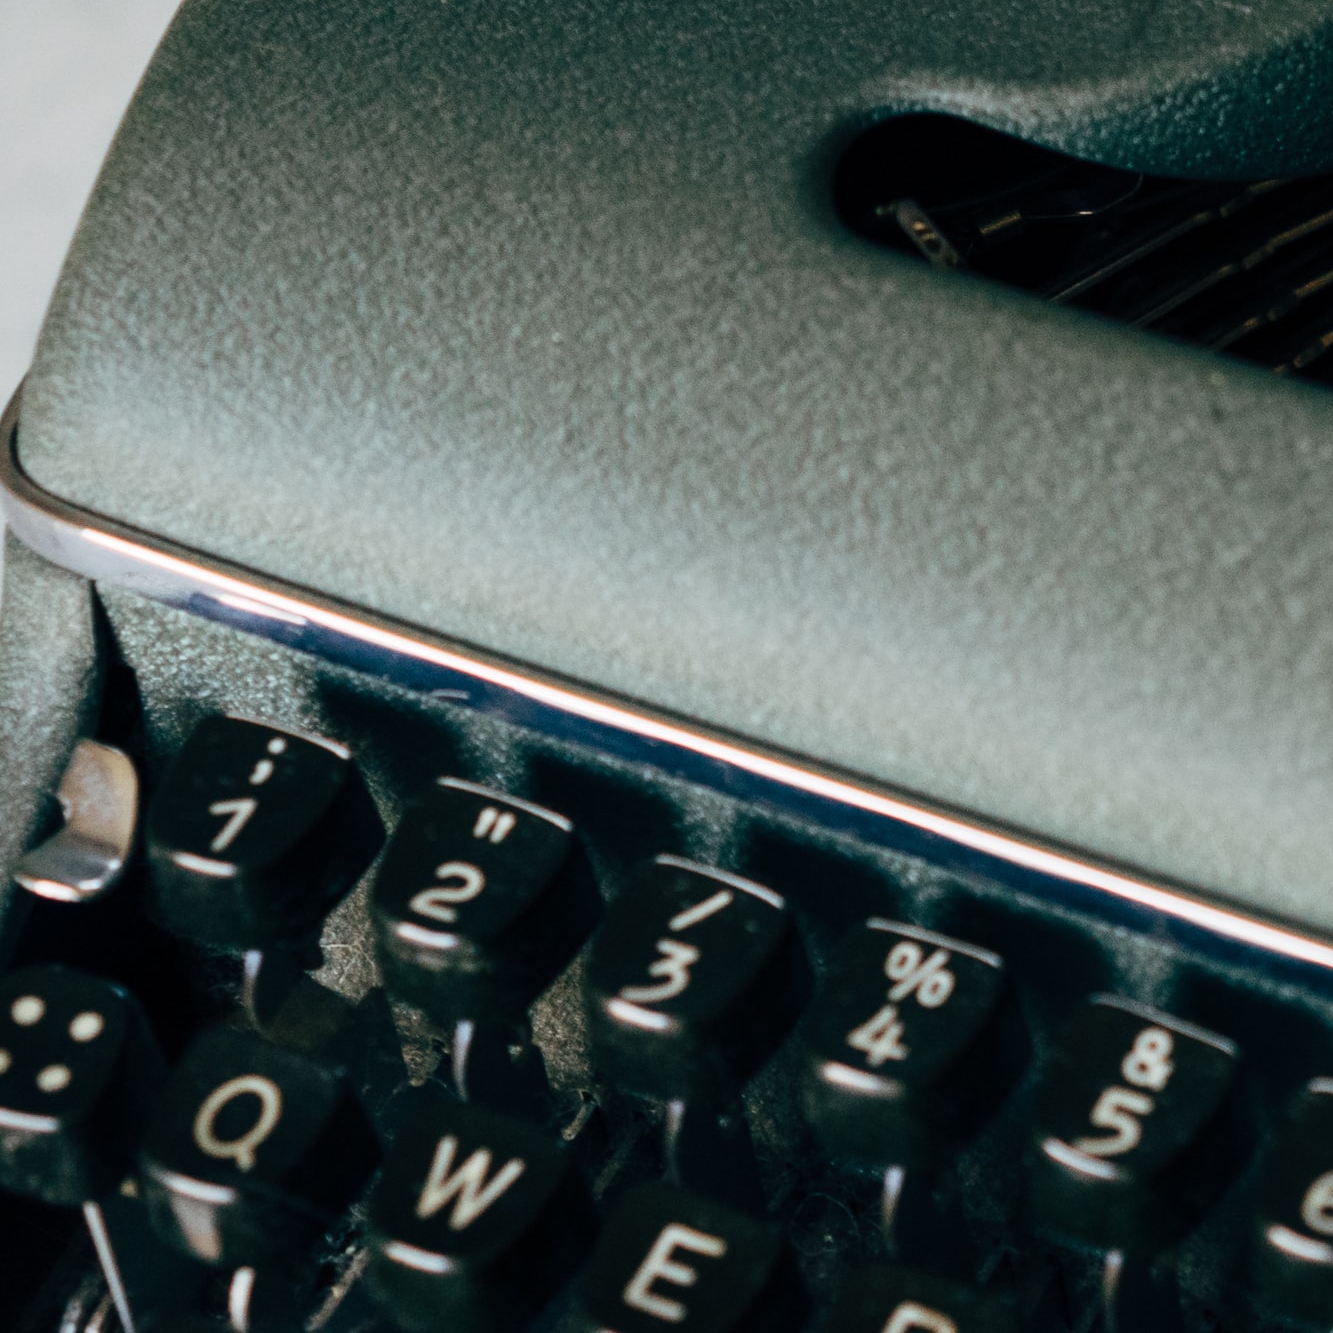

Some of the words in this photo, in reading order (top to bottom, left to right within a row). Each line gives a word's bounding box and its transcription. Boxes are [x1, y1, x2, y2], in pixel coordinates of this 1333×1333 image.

[211, 799, 256, 850] 1
[411, 862, 484, 921] 2
[618, 940, 699, 1003] 3
[883, 941, 955, 1008] %
[847, 1005, 908, 1067] 4
[196, 1076, 280, 1169] Q
[1074, 1086, 1154, 1157] 5
[419, 1137, 522, 1227] W
[626, 1225, 723, 1319] E
